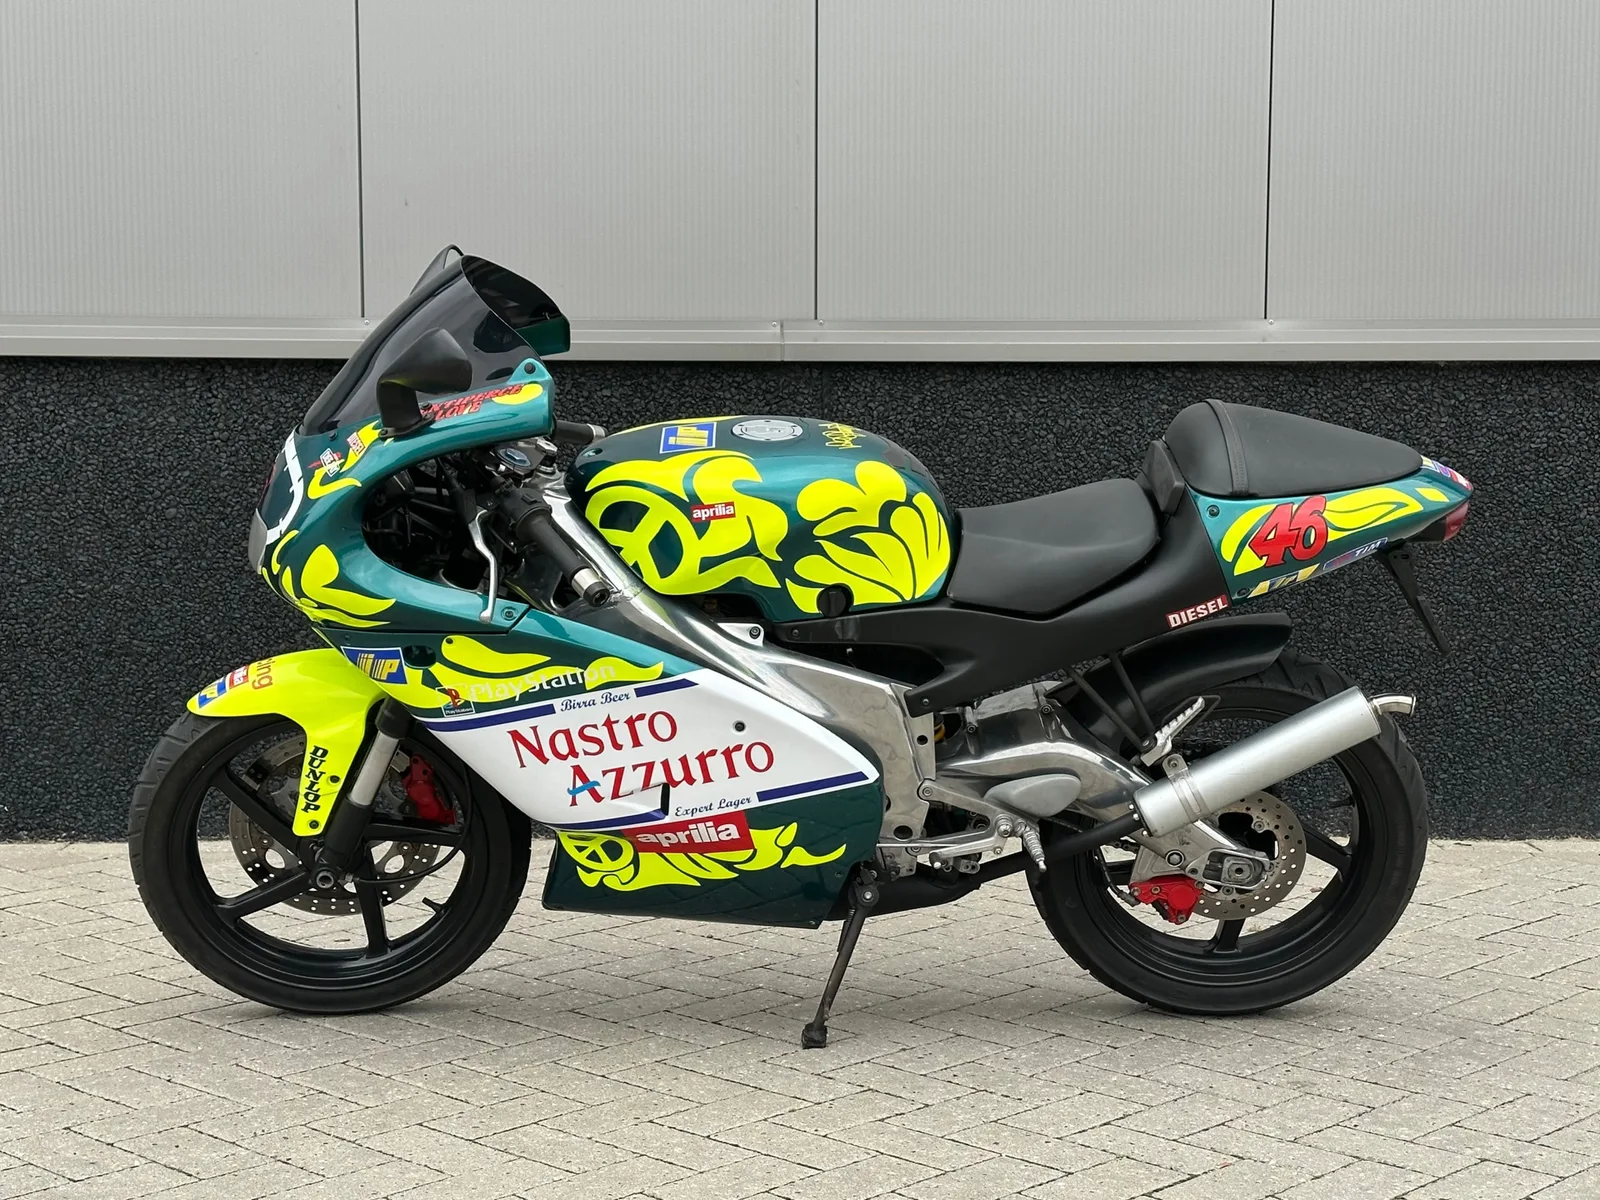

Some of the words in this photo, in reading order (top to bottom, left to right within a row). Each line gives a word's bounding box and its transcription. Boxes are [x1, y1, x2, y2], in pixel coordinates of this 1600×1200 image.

[692, 504, 735, 520] aprilia
[1249, 495, 1328, 568] 46
[1355, 541, 1382, 557] TIM
[1167, 598, 1229, 629] DIESEL
[470, 665, 616, 701] PlayStation
[560, 699, 597, 712] Birra
[600, 691, 631, 705] Beer
[506, 710, 678, 768] Nastro
[301, 745, 329, 813] DUNLOP
[567, 741, 774, 807] Azzurro
[675, 803, 714, 818] Expert
[717, 796, 752, 812] Lager
[636, 820, 740, 847] aprilia
